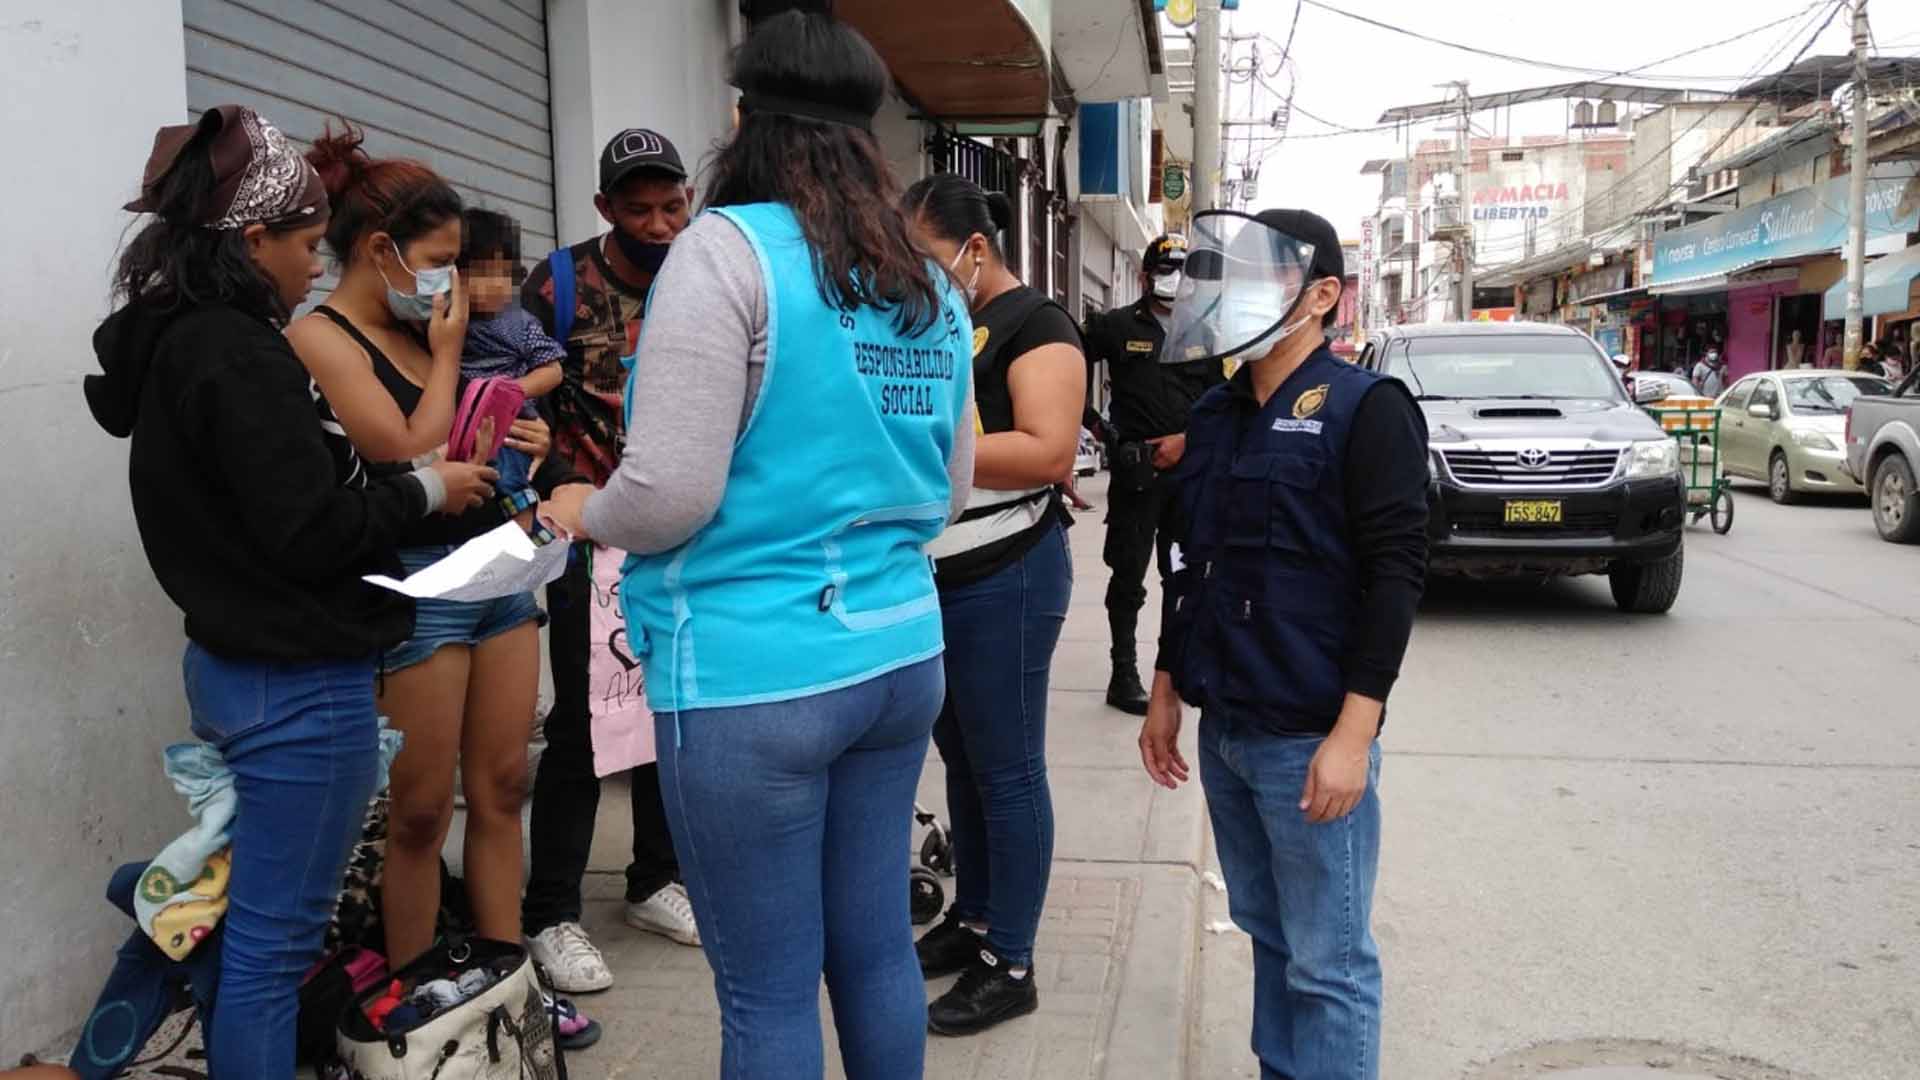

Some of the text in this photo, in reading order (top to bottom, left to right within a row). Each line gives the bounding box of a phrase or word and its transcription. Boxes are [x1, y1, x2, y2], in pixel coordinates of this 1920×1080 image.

[1473, 183, 1568, 204] ARMACIA
[1473, 206, 1549, 220] LIBERTAD
[881, 384, 933, 415] SOCIAL
[1506, 504, 1559, 521] T5S-847
